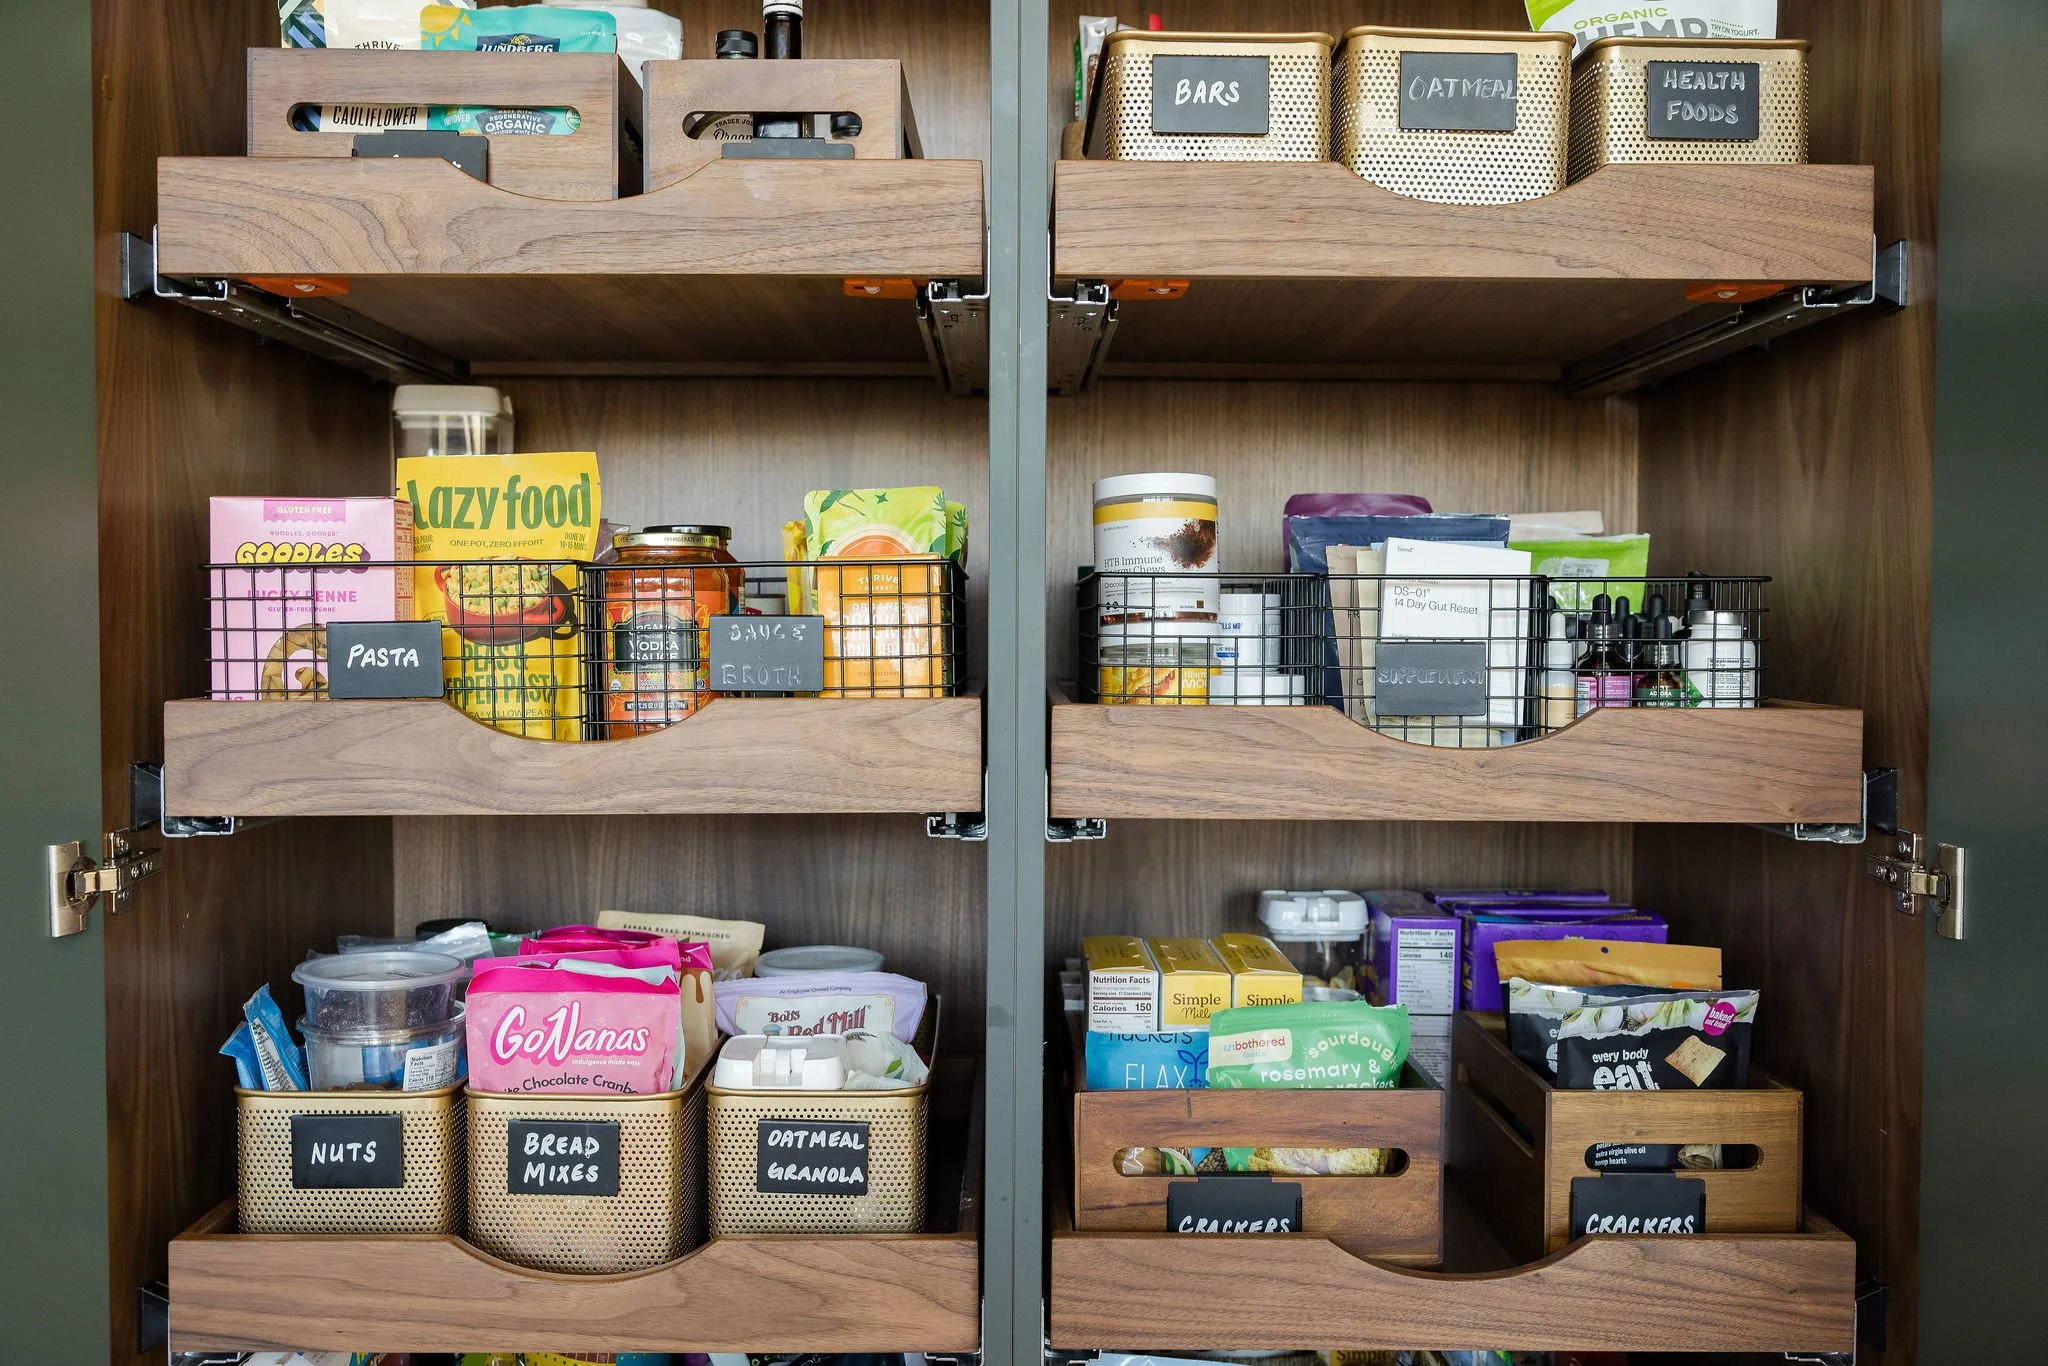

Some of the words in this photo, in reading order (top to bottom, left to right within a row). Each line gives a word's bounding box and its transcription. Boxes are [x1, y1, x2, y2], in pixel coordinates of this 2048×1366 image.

[1573, 7, 1668, 30] ORGANIC
[1711, 24, 1722, 33] TRY
[1722, 26, 1730, 34] ON
[1409, 76, 1516, 102] OATMEAL
[1663, 70, 1746, 90] HEALTH
[1175, 79, 1240, 106] BARS
[332, 106, 417, 127] CAULIFLOWER
[490, 114, 542, 123] REGENERATIVE
[1666, 100, 1739, 124] FOODS
[486, 122, 546, 133] ORGANIC
[715, 118, 740, 128] TRADER
[277, 506, 309, 514] GLUTEN
[312, 506, 333, 514] FREE
[470, 540, 488, 548] POT,
[513, 539, 544, 547] EFFORT
[565, 532, 578, 541] DONE
[1104, 558, 1120, 568] HTB
[1122, 555, 1162, 566] Immune
[1394, 598, 1404, 607] 14
[1407, 599, 1426, 612] Day
[1429, 602, 1447, 612] Gut
[1450, 604, 1478, 615] Reset
[730, 624, 806, 642] SAUCE
[629, 641, 679, 650] VODKA
[347, 644, 418, 668] PASTA
[464, 644, 509, 672] PEAS
[722, 663, 802, 686] BROTH
[444, 674, 498, 705] EPPER
[504, 673, 559, 704] PASTA
[1136, 1002, 1152, 1011] 150
[1172, 993, 1221, 1006] Simple
[1247, 994, 1295, 1005] Simple
[768, 1010, 800, 1023] Bob's
[787, 1016, 825, 1036] Red
[826, 1004, 866, 1034] Mill
[1709, 1007, 1734, 1024] baked,
[495, 1002, 649, 1061] GoNanas
[1224, 1036, 1285, 1052] unbothered
[1592, 1051, 1619, 1064] every
[1622, 1048, 1649, 1063] body
[1260, 1062, 1361, 1082] rosemary
[1368, 1059, 1381, 1074] &
[523, 1072, 589, 1091] Chocolate
[524, 1132, 600, 1158] BREAD
[768, 1130, 865, 1150] OATMEAL
[311, 1140, 378, 1165] NUTS
[1609, 1148, 1623, 1156] virgin
[524, 1162, 599, 1187] MIXES
[768, 1162, 864, 1184] GRANOLA
[1178, 1215, 1290, 1233] CRACKERS
[1586, 1214, 1695, 1234] CRACKERS
